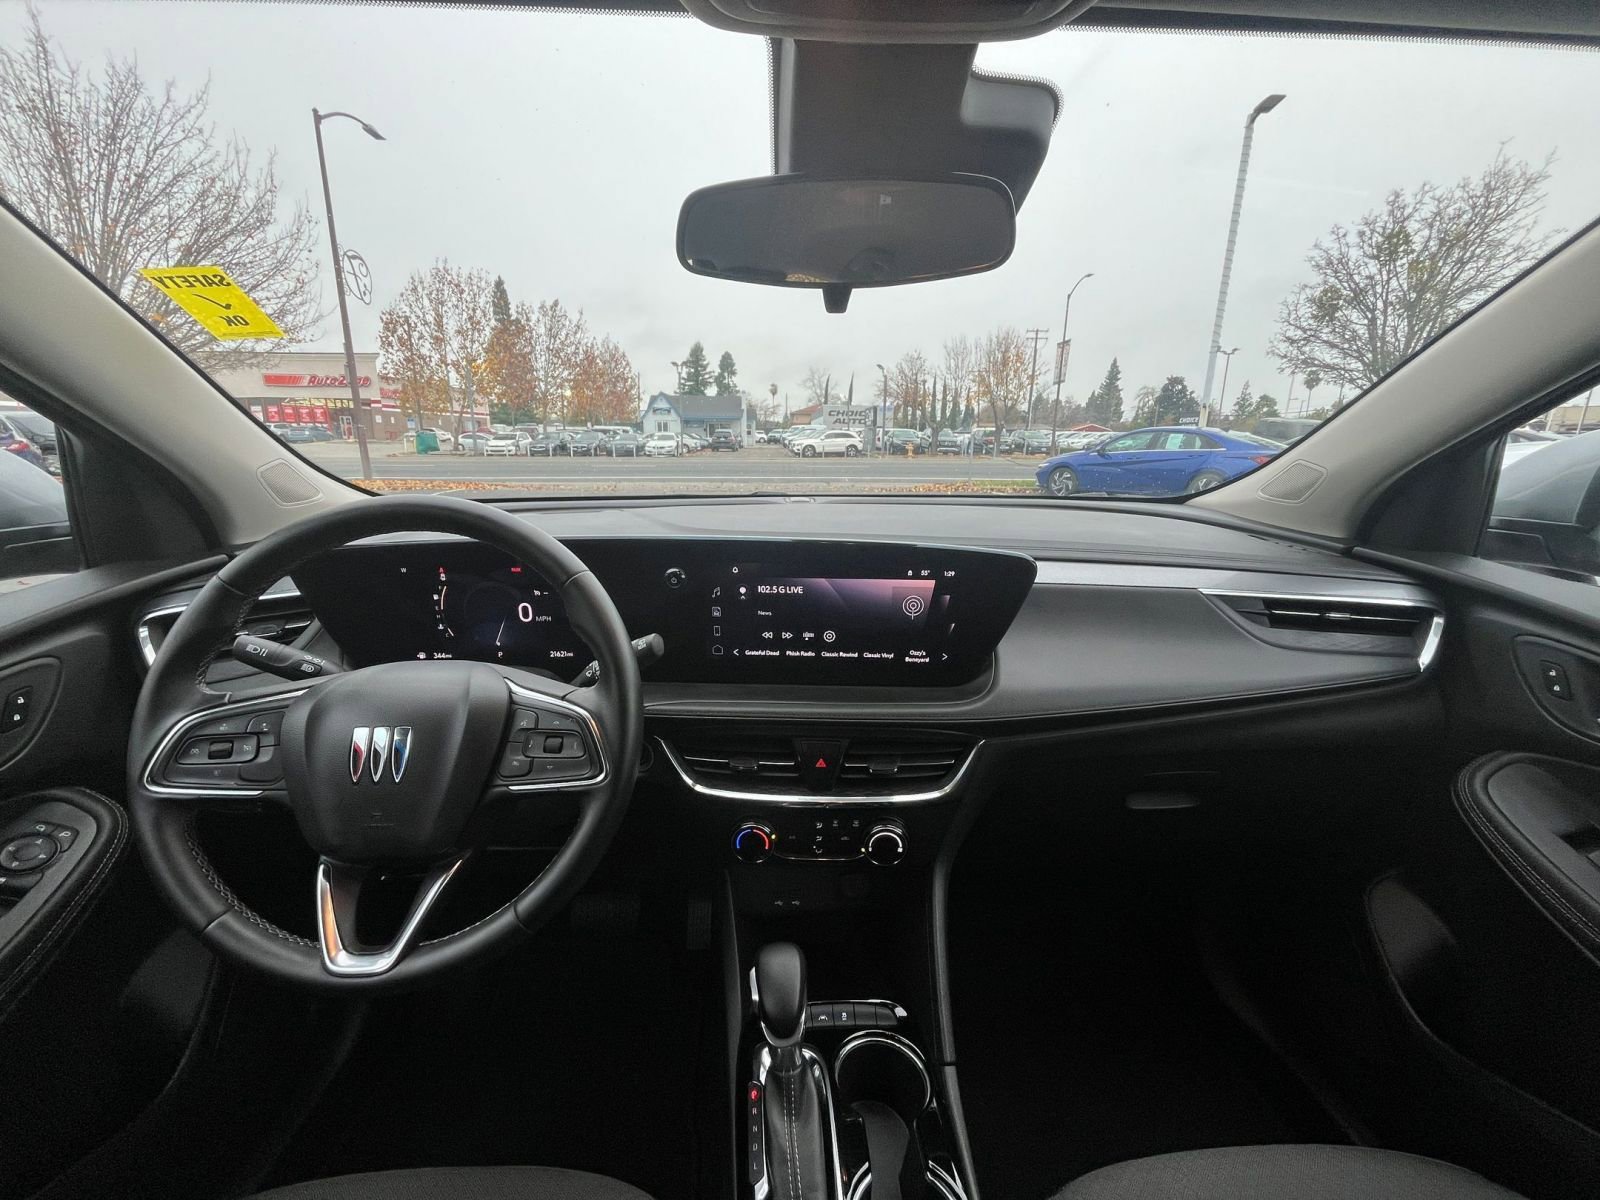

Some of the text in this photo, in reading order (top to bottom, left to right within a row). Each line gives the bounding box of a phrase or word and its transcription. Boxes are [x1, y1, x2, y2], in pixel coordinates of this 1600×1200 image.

[307, 373, 372, 388] AutoZne
[757, 585, 804, 594] 102.5 G LIVE
[517, 602, 533, 622] 0
[881, 652, 894, 660] Vinyl
[752, 1125, 758, 1133] N
[752, 1143, 758, 1151] D
